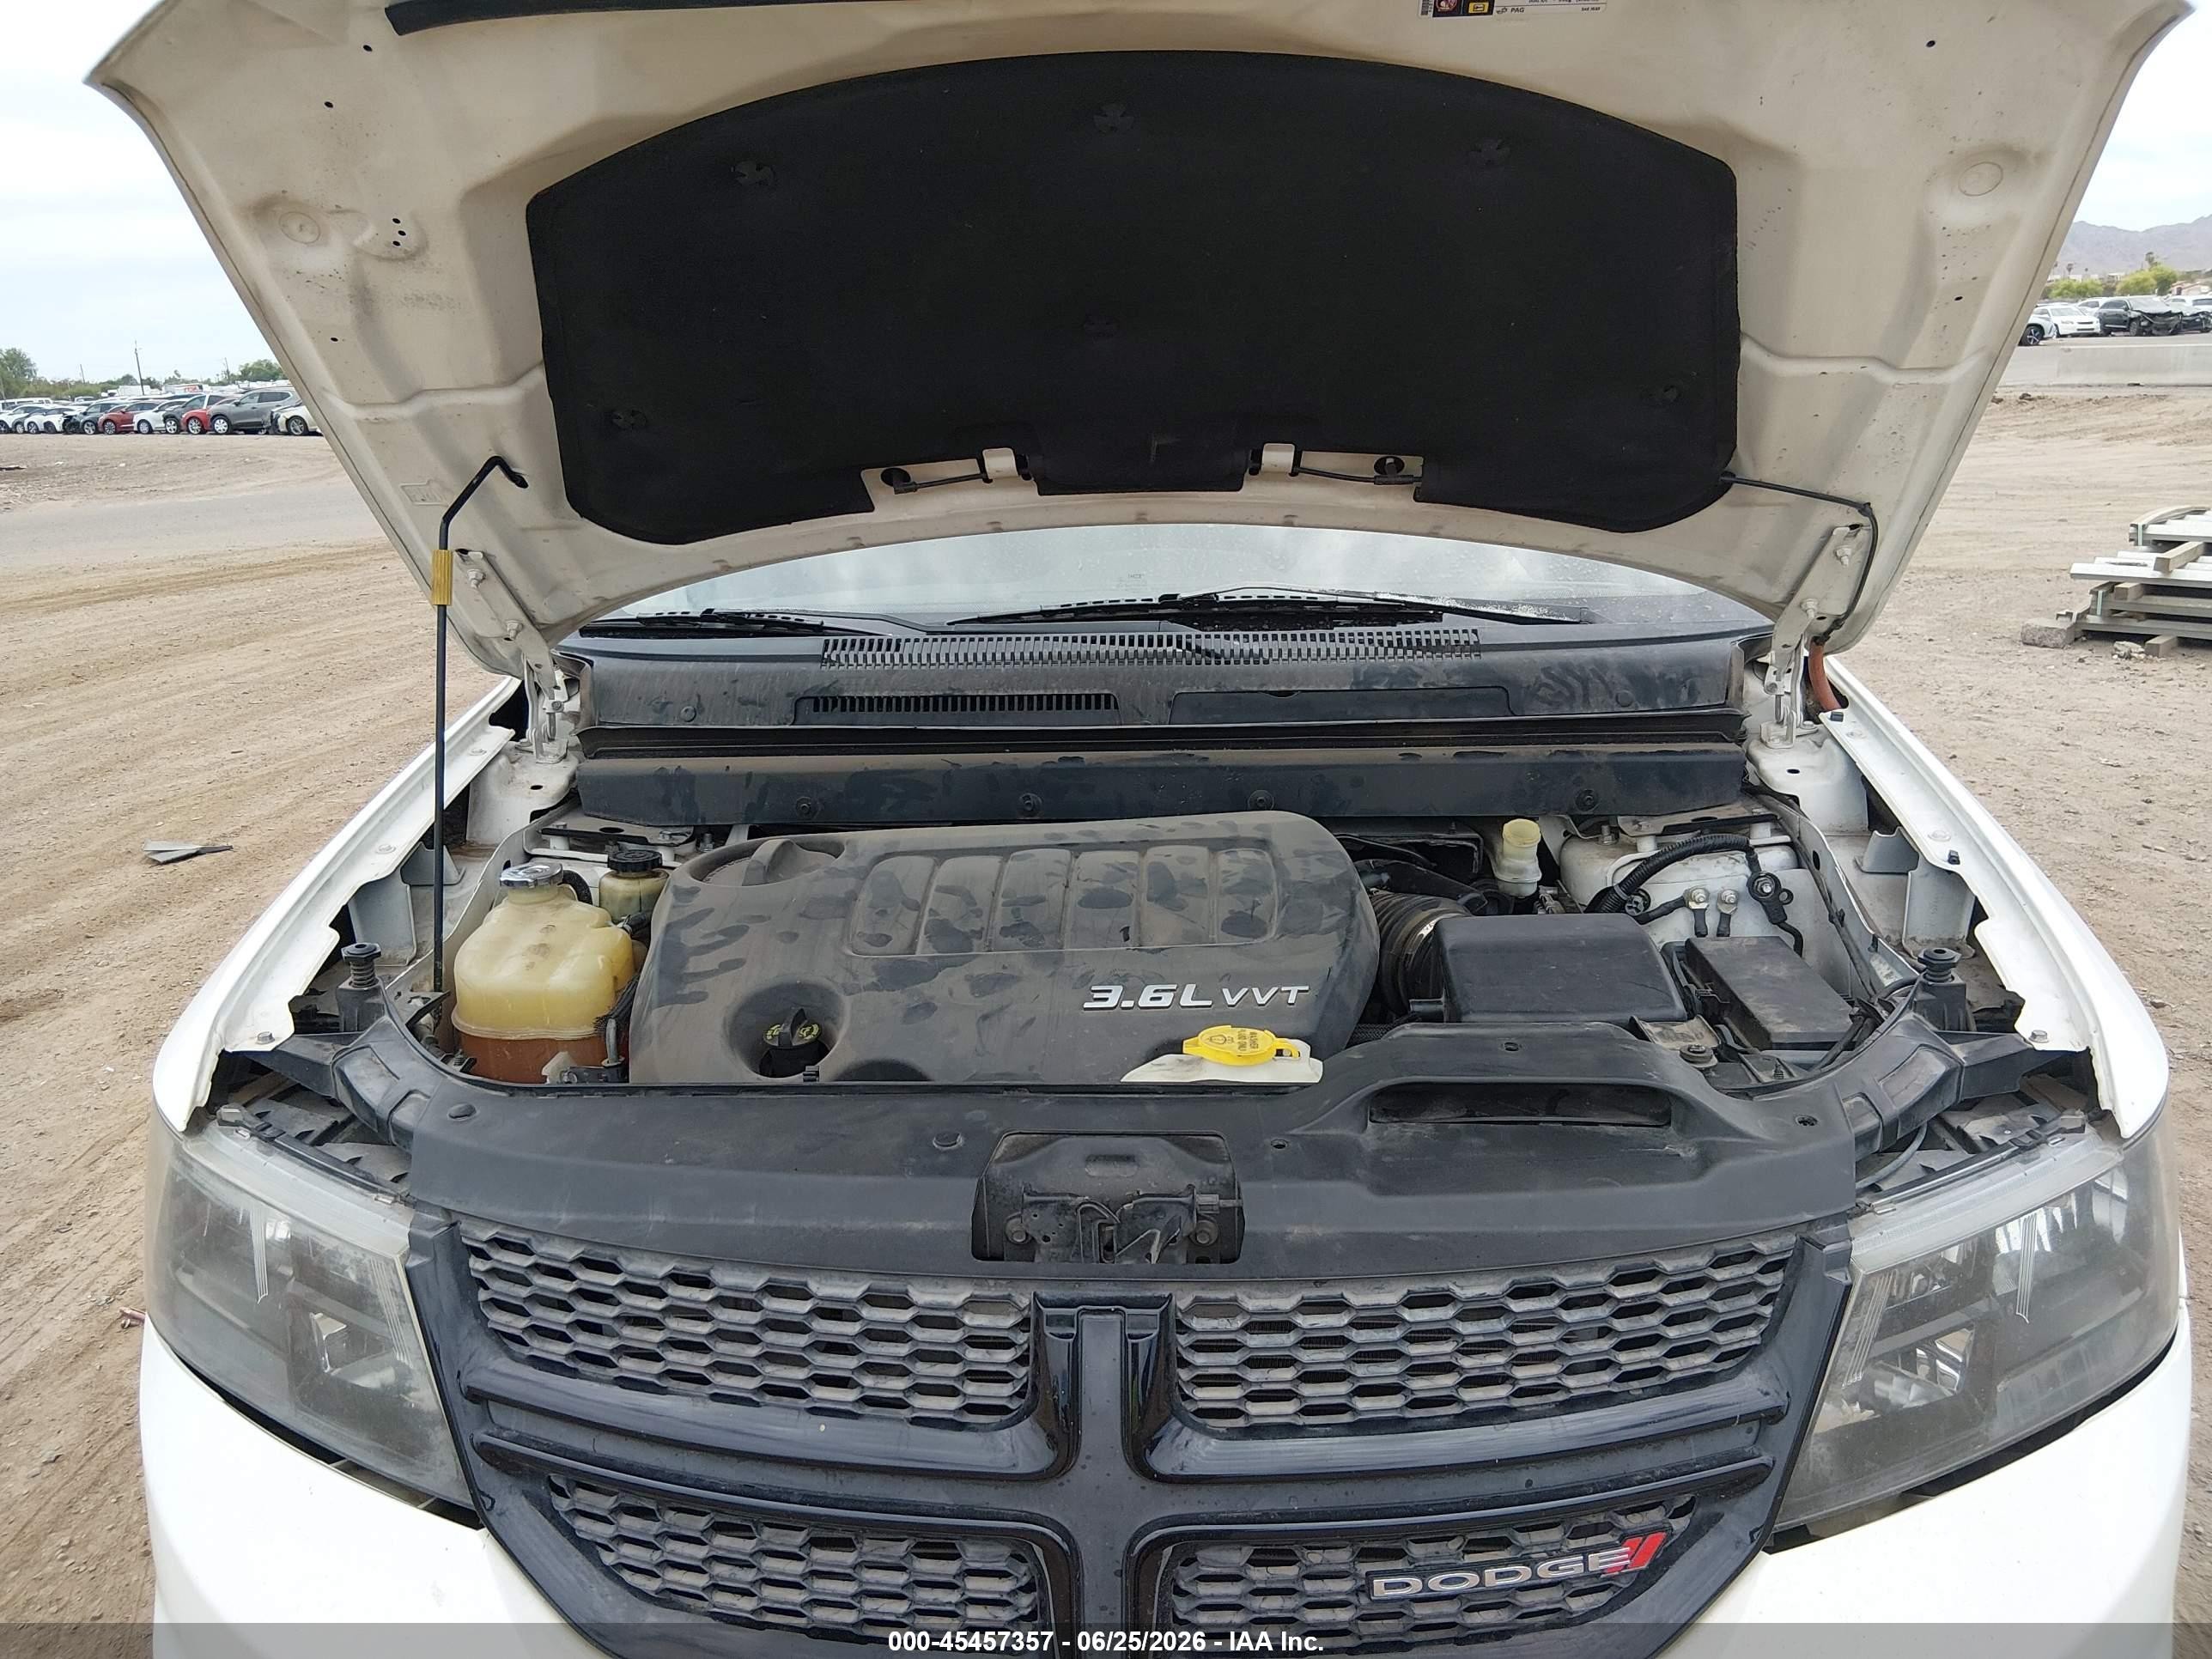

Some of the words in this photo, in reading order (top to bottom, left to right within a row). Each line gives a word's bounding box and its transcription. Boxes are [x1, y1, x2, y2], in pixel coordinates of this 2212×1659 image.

[1084, 984, 1212, 1010] 3.6L
[1222, 985, 1310, 1006] VVT
[1249, 1031, 1259, 1049] WASHER
[1372, 1547, 1631, 1597] DODGE
